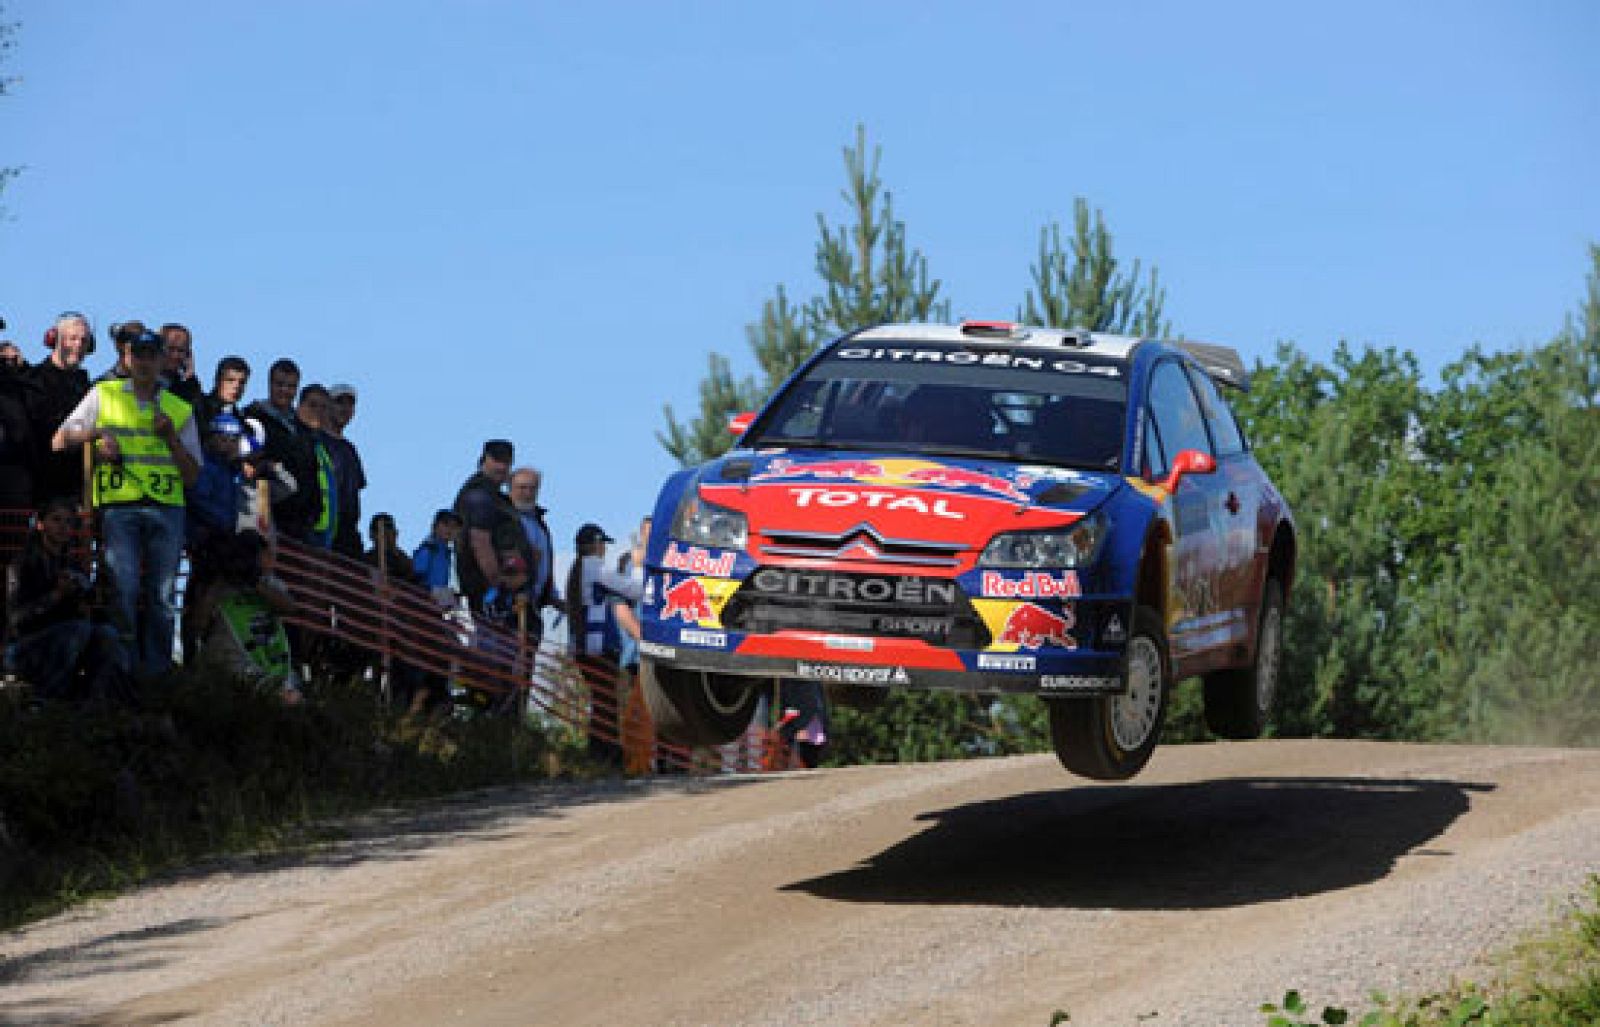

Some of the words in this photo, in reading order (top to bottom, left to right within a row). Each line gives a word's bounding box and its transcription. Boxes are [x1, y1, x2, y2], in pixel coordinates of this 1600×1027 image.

[837, 347, 1043, 371] CITROËN
[788, 488, 966, 519] TOTAL
[690, 547, 737, 577] Bull
[753, 569, 955, 604] CITROËN
[981, 570, 1035, 597] Red
[1036, 569, 1082, 597] Bull
